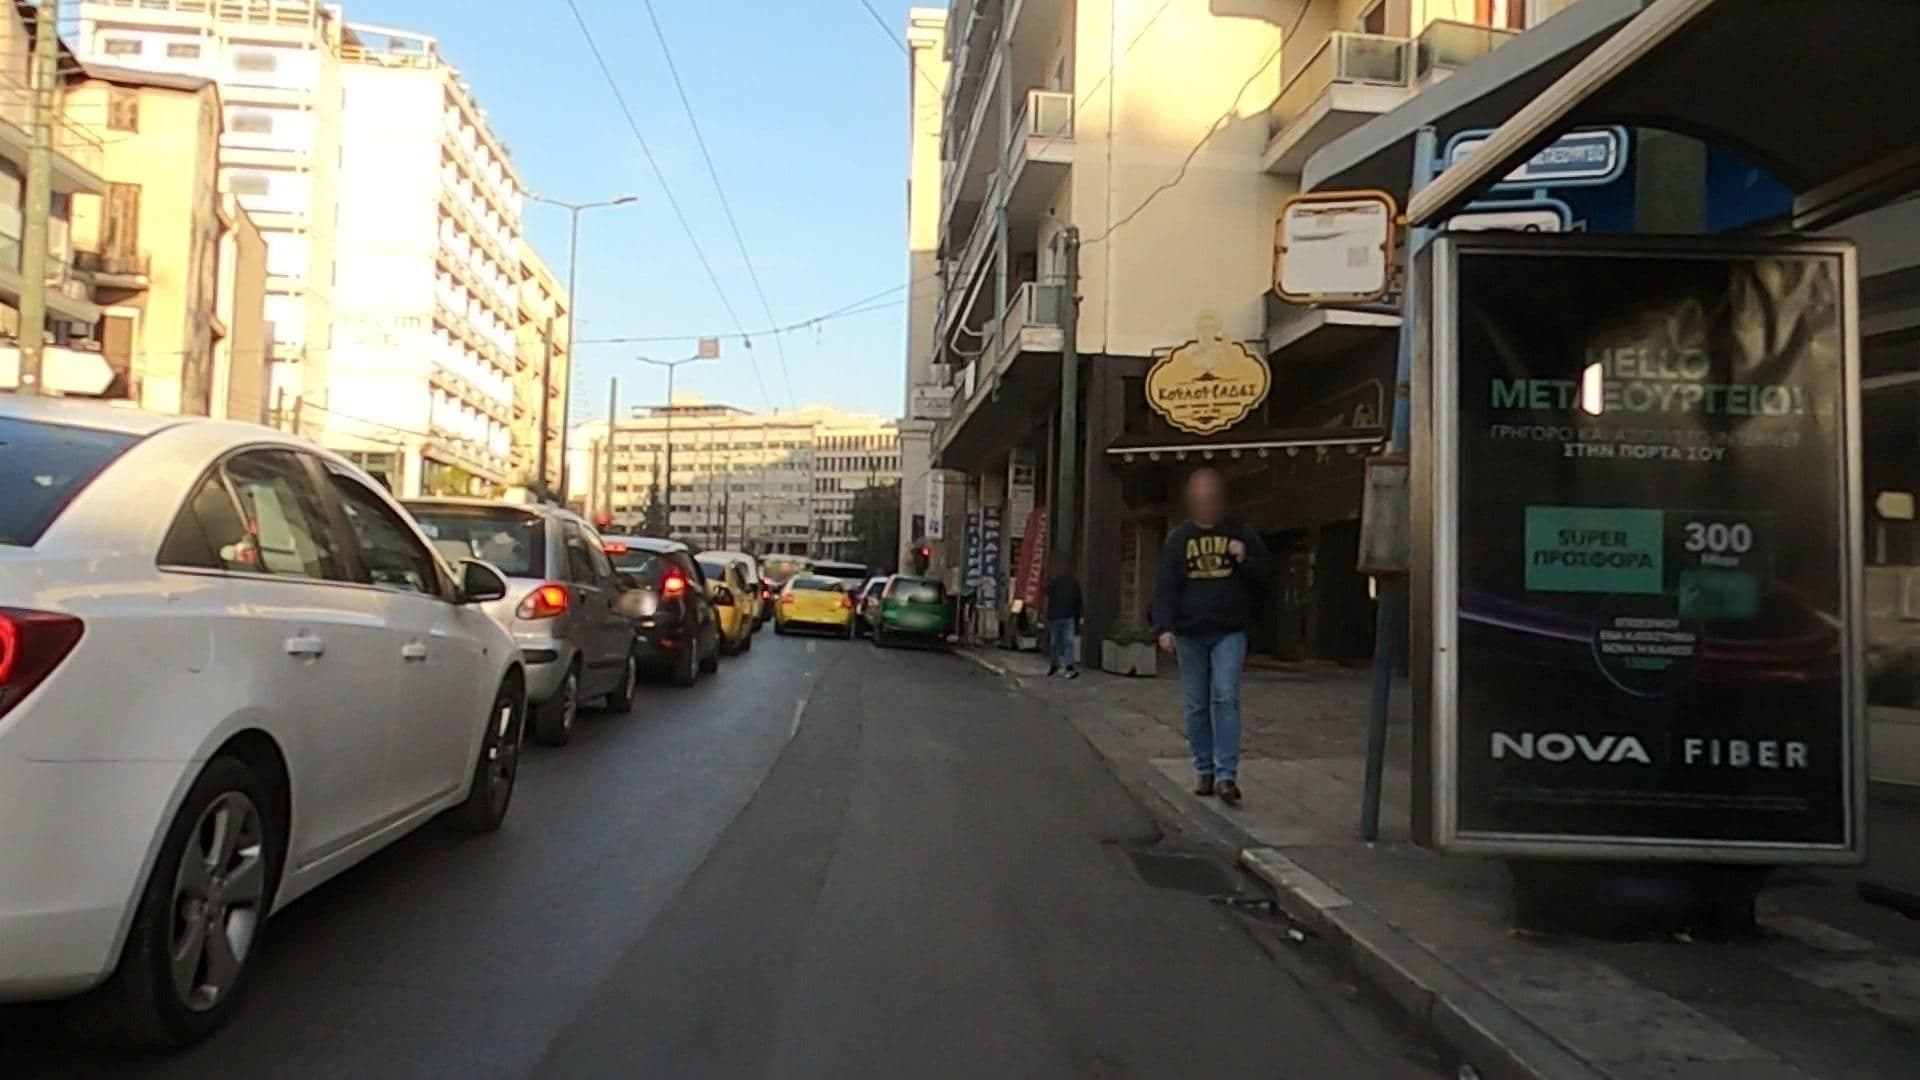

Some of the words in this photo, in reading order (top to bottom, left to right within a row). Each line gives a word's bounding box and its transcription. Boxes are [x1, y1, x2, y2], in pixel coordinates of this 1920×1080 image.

[1563, 443, 1615, 457] ΣΤΗΝ
[1619, 444, 1681, 459] ΠΟΡΤΑ
[1687, 447, 1726, 460] ΣΟΥ
[1557, 529, 1628, 547] SUPER
[1683, 522, 1753, 553] 300
[1533, 550, 1654, 569] ΠΡΟΣΦΟΡΑ
[1491, 732, 1651, 763] NOVA
[1684, 738, 1808, 768] FIBER
